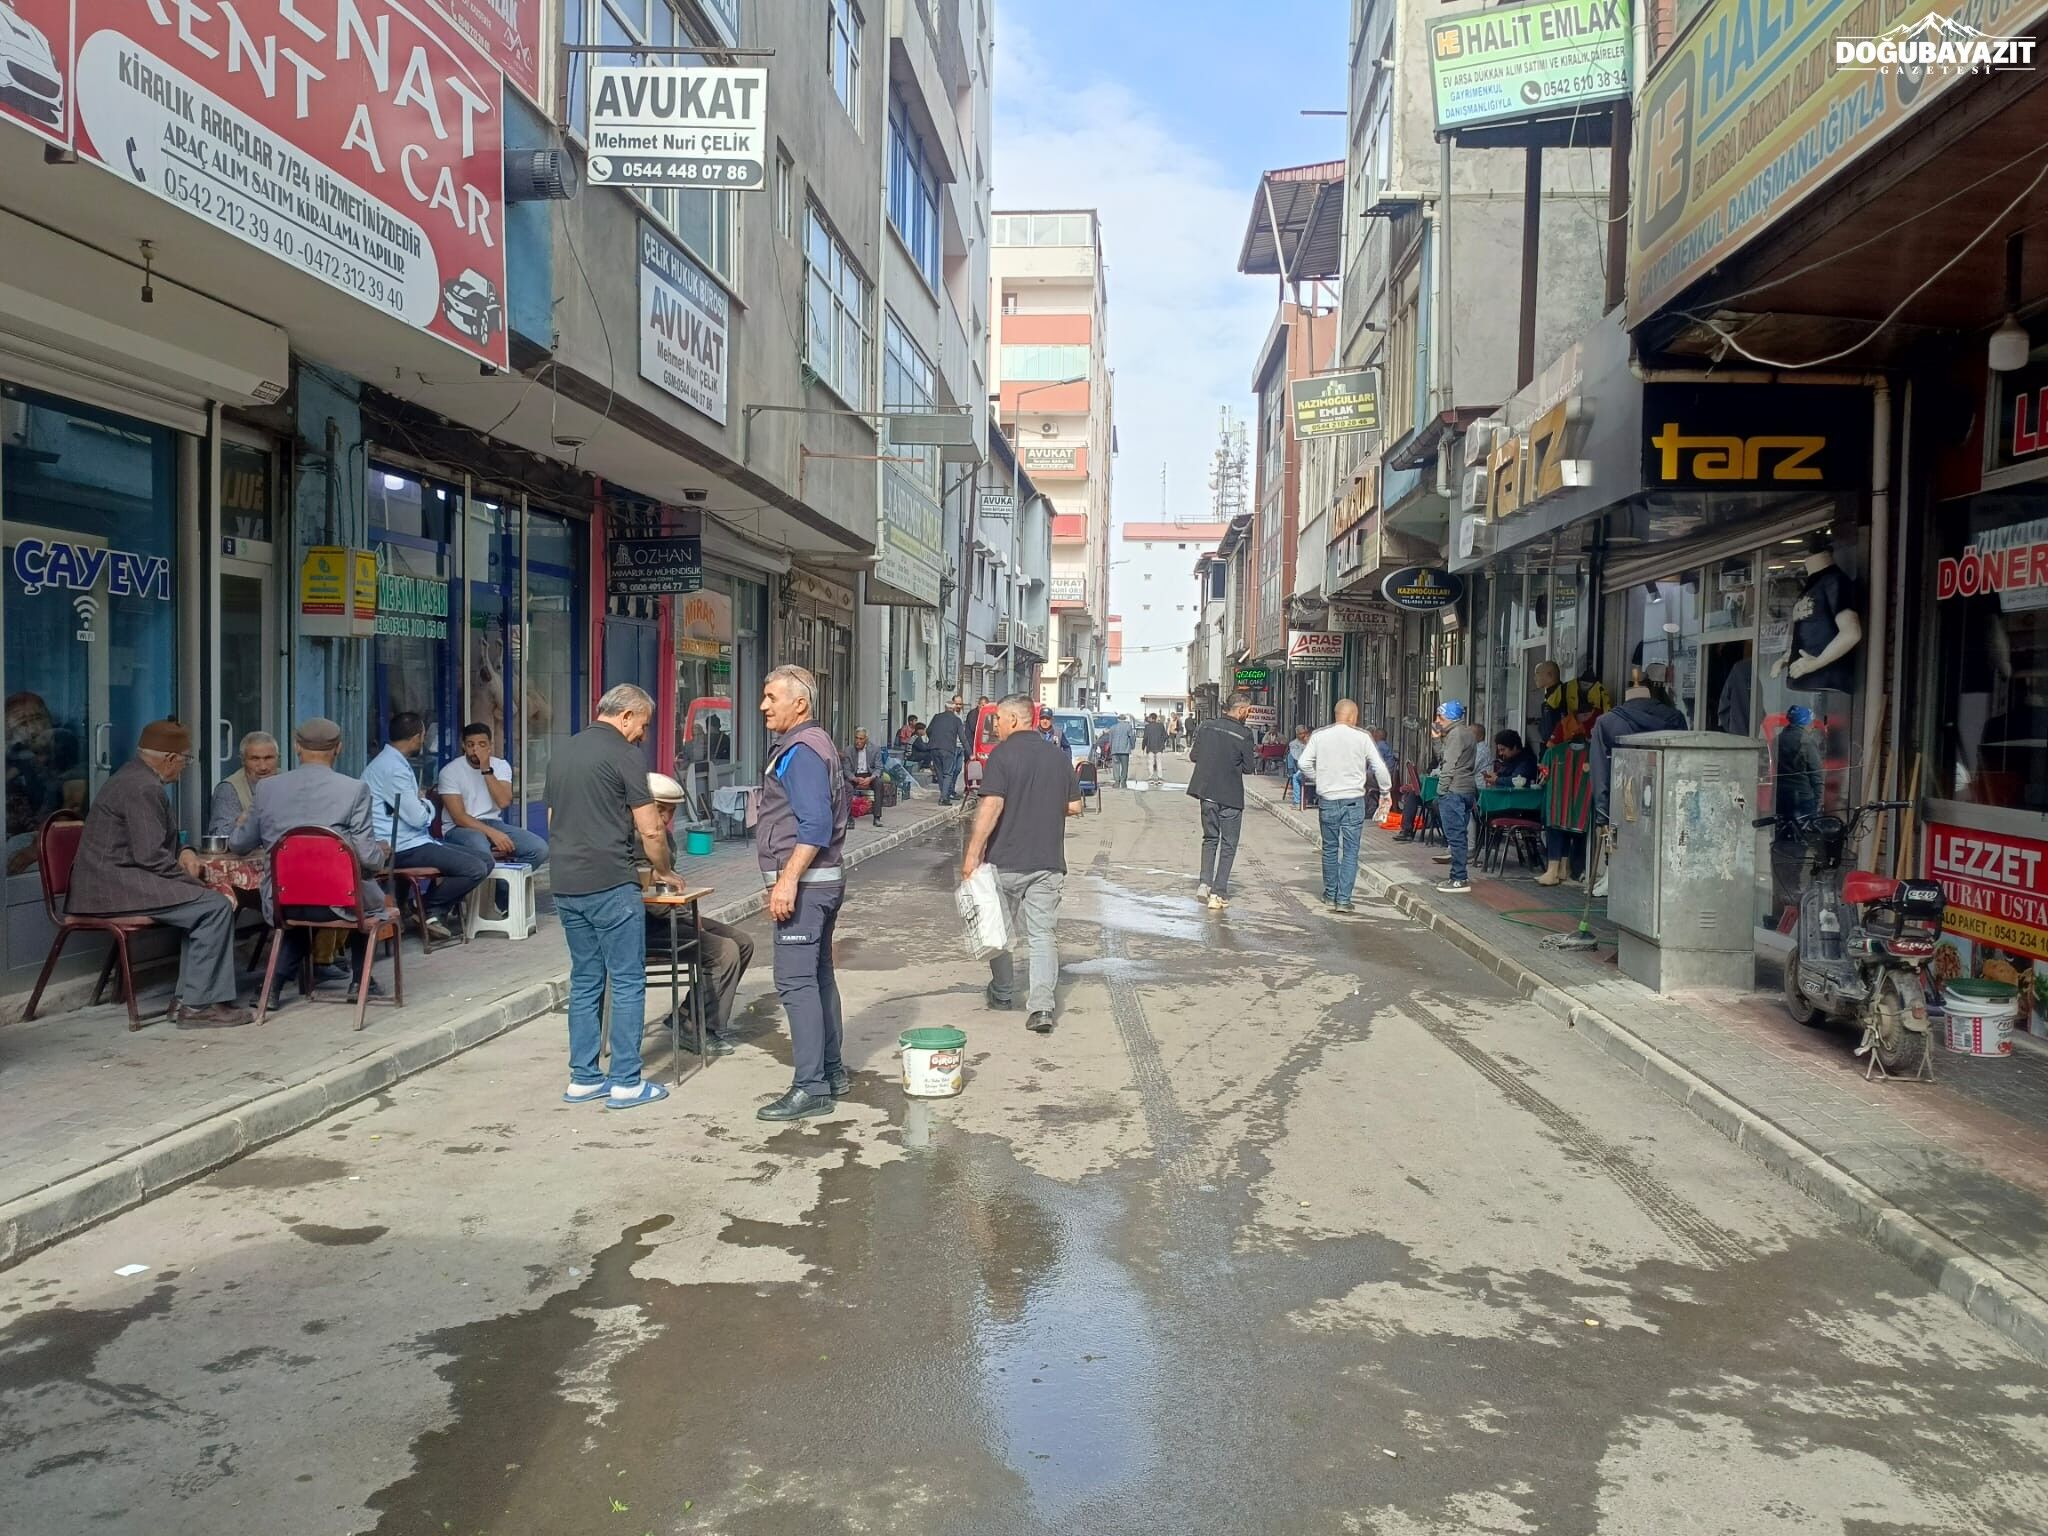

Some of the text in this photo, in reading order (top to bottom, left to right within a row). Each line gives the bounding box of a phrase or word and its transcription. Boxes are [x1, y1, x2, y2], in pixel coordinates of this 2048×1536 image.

[1540, 0, 1621, 41] EMLAK
[1443, 76, 1452, 88] EV
[1454, 73, 1473, 86] ARSA
[1506, 64, 1523, 76] ALIM
[1524, 60, 1548, 73] SATIMI
[1549, 57, 1559, 68] VE
[1543, 69, 1628, 97] 0542 610 38 34
[594, 75, 759, 119] AVUKAT
[119, 50, 421, 259] KİRALIK ARAÇLAR 7/24 HİZMETİNİZDEDİR
[594, 132, 750, 155] Mehmet Nuri ÇELİK
[1726, 71, 1886, 237] DANIŞMANLIĞIYLA
[340, 104, 386, 173] A
[400, 144, 494, 247] CAR
[622, 162, 748, 180] 0544 448 07 86
[163, 121, 405, 275] ARAÇ ALIM SATIM KİRALAMA YAPILIR
[164, 168, 212, 214] 0542
[216, 195, 245, 231] 212
[249, 213, 269, 243] 39
[273, 228, 293, 255] 40
[343, 262, 366, 293] 312
[368, 276, 384, 301] 39
[387, 287, 403, 312] 40
[671, 256, 699, 298] HUKUK
[650, 285, 724, 374] AVUKAT
[657, 340, 685, 374] Mehmet
[686, 359, 699, 380] Nuri
[1319, 405, 1353, 417] EMLAK
[1028, 449, 1073, 458] AVUKAT
[1652, 423, 1826, 480] tarz
[983, 496, 1013, 505] AVUKA
[634, 547, 692, 565] ÖZHAN
[1937, 541, 2048, 600] DÖNER
[1934, 834, 2042, 889] LEZZET
[2000, 894, 2048, 927] USTA
[1959, 915, 1987, 933] PAKET
[1994, 925, 2017, 943] 0543
[2020, 931, 2037, 948] 234
